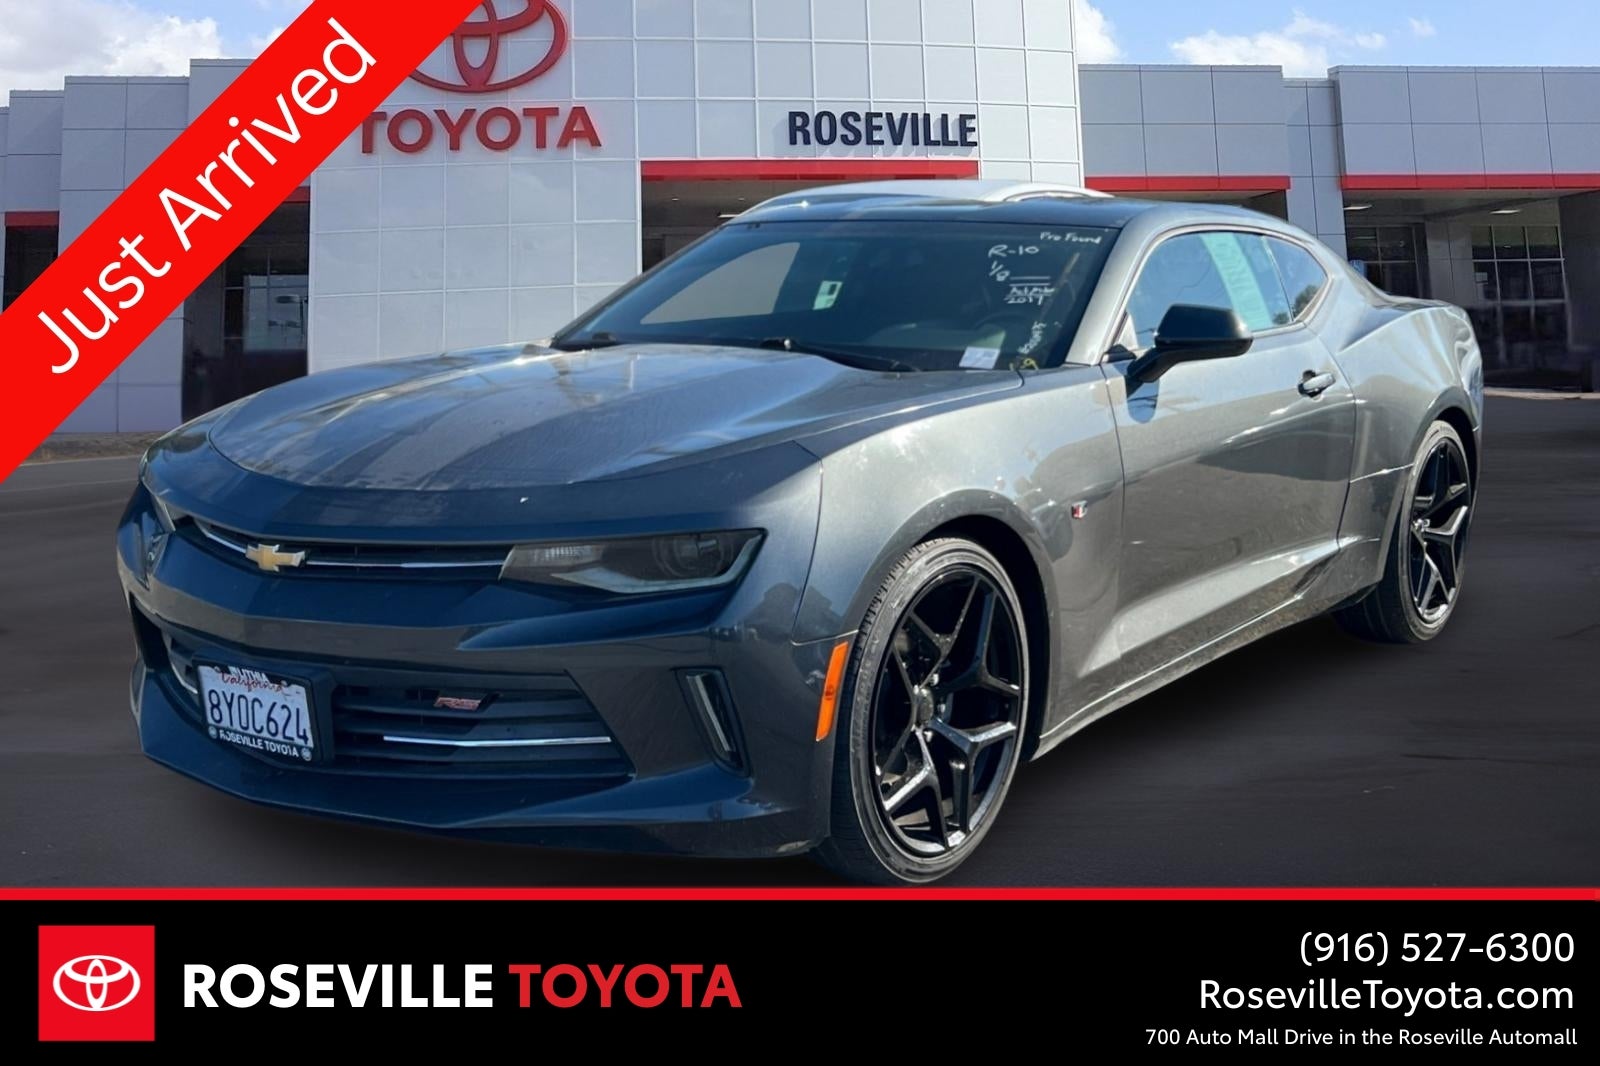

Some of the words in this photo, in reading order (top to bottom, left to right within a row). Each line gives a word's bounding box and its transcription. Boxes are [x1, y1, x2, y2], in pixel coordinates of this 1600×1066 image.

[361, 106, 601, 154] TOYOTA
[789, 110, 978, 147] ROSEVILLE
[219, 729, 263, 749] ROSEVILLE
[264, 740, 299, 757] TOYOTA
